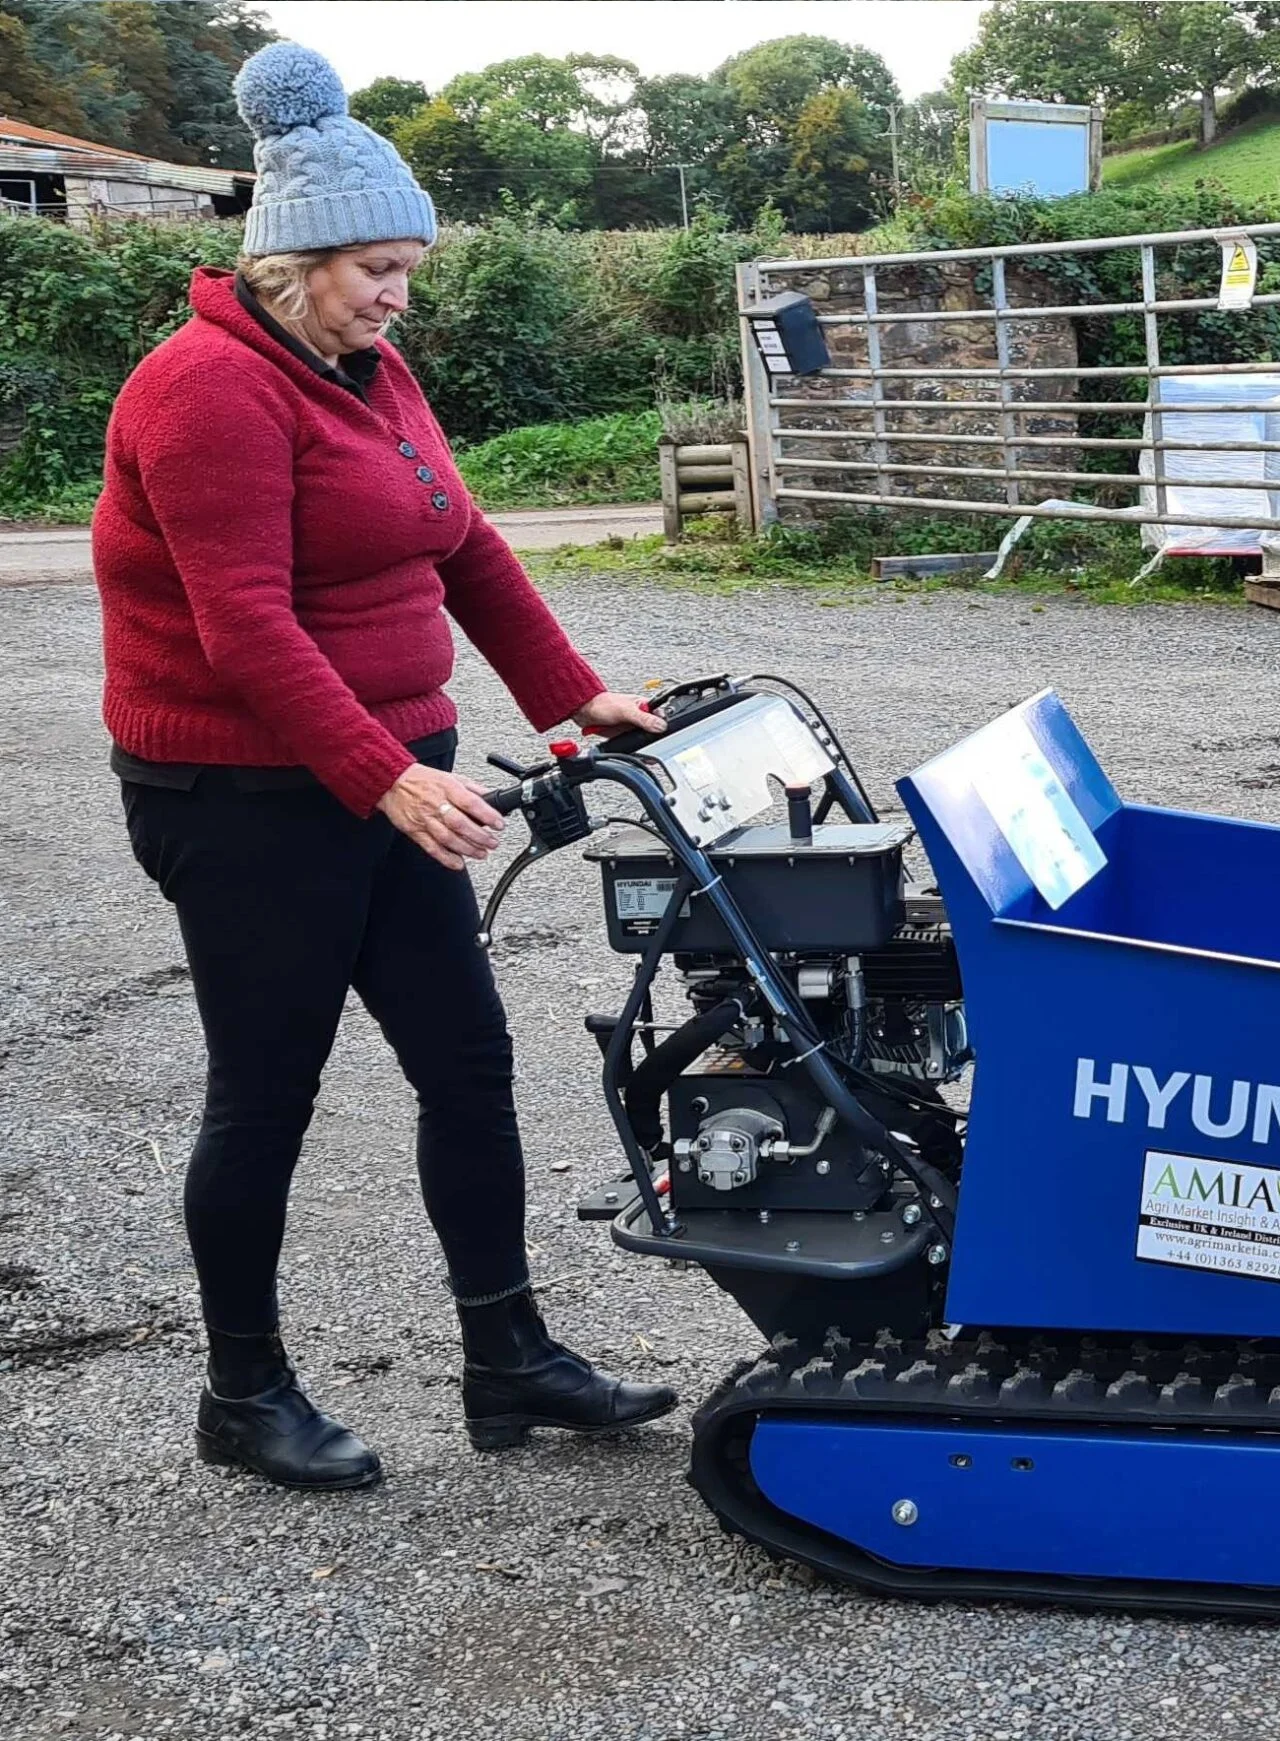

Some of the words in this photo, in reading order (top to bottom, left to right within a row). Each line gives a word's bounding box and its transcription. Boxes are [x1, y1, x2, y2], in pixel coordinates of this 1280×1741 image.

[1149, 1162, 1279, 1213] AMIA
[1145, 1199, 1169, 1215] Agri
[1173, 1202, 1213, 1220] Market
[1217, 1209, 1256, 1227] Insight
[1260, 1216, 1268, 1229] &
[1149, 1216, 1191, 1231] Exclusive
[1193, 1223, 1208, 1233] UK
[1210, 1226, 1218, 1235] &
[1220, 1228, 1252, 1240] Ireland
[1167, 1249, 1191, 1261] +44
[1195, 1253, 1241, 1269] (0)1363
